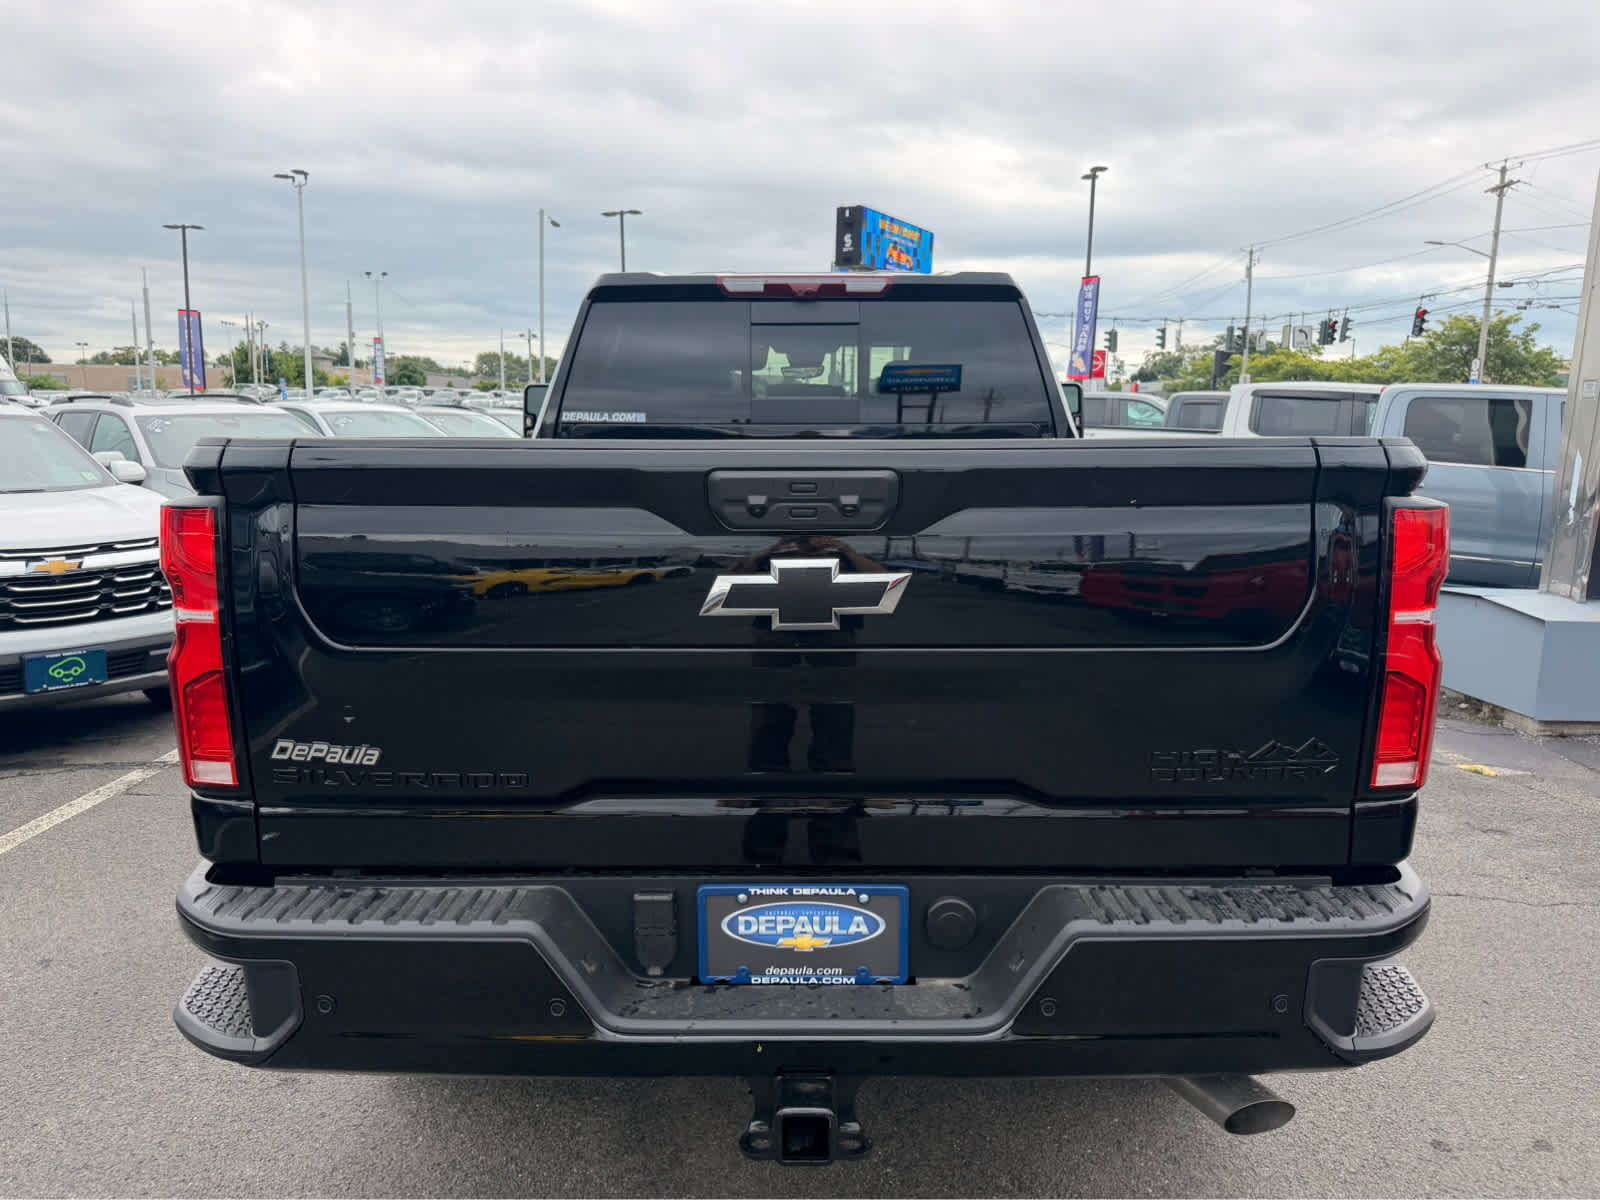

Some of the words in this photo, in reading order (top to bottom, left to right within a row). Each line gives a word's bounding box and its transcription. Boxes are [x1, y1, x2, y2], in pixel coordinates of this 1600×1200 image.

[562, 411, 636, 422] DEPAULA.COM
[271, 739, 382, 765] DePaula
[271, 768, 529, 789] SILVERADO
[748, 888, 789, 896] THINK
[792, 888, 856, 896] DEPAULA
[737, 916, 870, 936] DEPAULA
[765, 965, 843, 977] depaula.com
[751, 977, 856, 985] DEPAULA.COM
